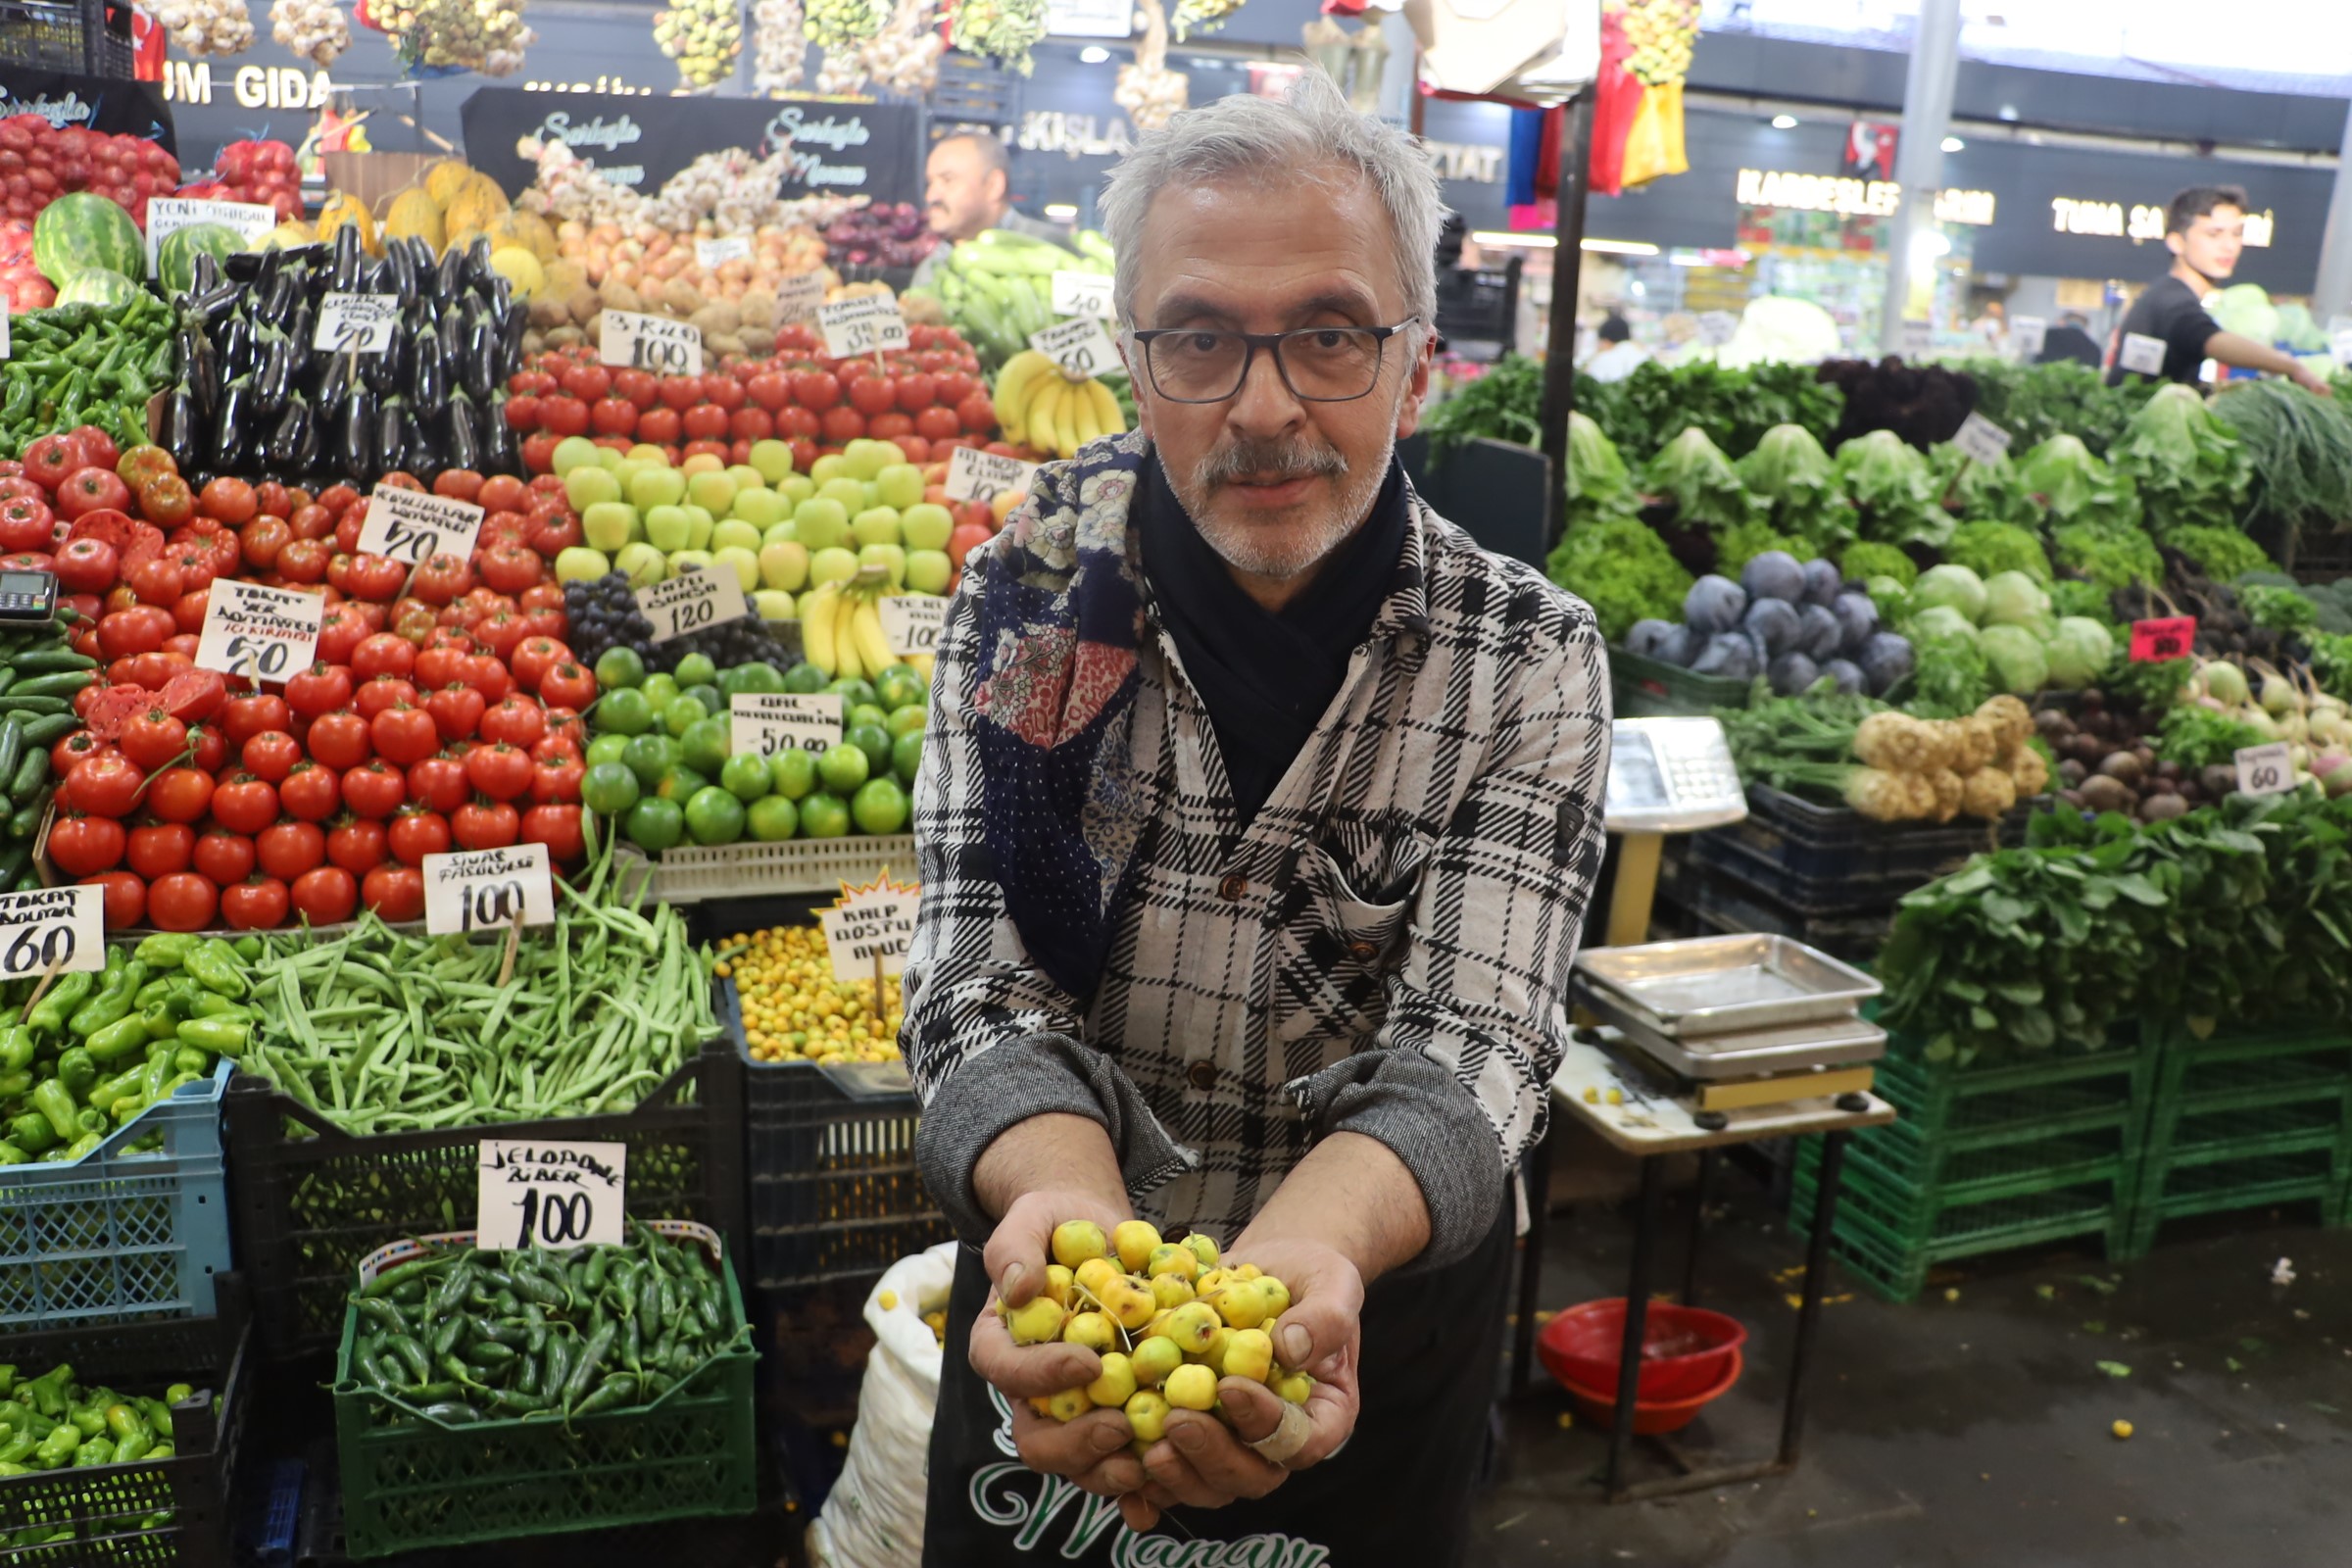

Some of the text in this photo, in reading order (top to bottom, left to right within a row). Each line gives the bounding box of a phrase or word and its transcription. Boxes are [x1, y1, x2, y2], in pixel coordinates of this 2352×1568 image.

[234, 66, 331, 110] GIDA
[631, 337, 688, 368] 100
[670, 599, 713, 633] 120
[226, 635, 288, 676] 50
[0, 889, 81, 910] TOKAT
[459, 879, 526, 934] 100
[843, 904, 899, 923] KALP
[3, 924, 75, 973] 60
[511, 1187, 594, 1251] 100
